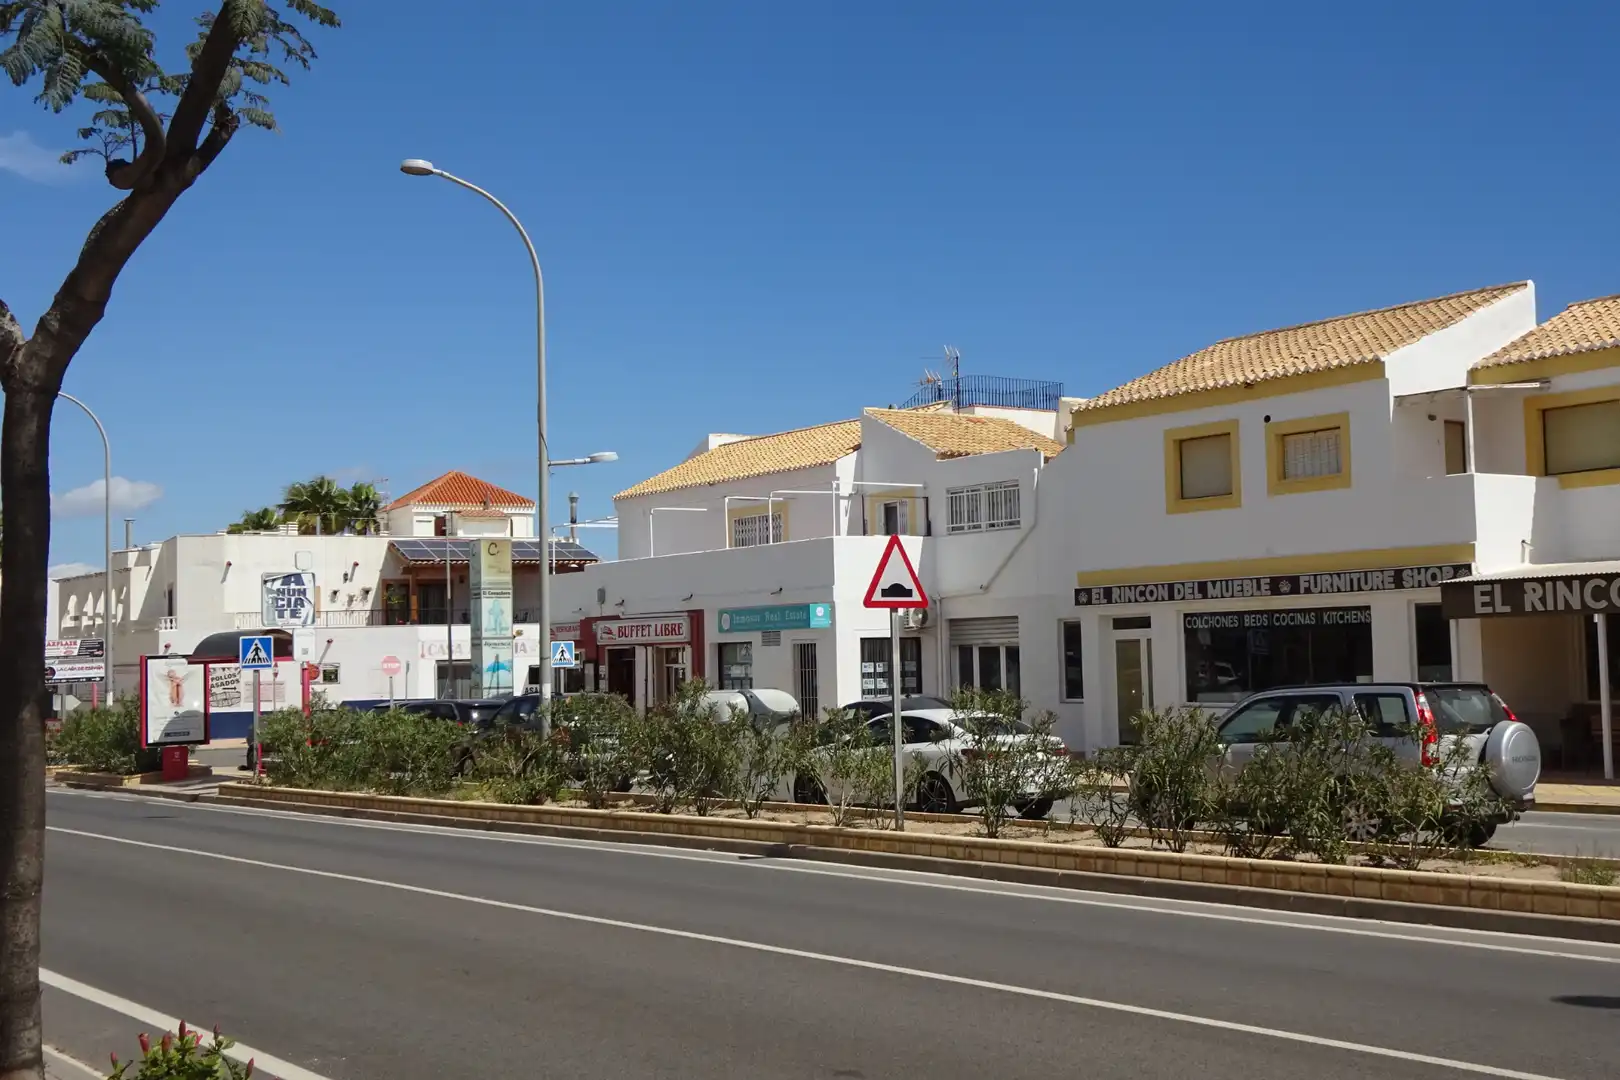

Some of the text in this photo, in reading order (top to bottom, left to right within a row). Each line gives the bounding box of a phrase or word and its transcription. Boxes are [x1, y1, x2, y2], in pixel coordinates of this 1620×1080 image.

[280, 573, 306, 587] A
[1300, 566, 1454, 595] FURNITURE SHOP
[276, 588, 307, 597] NUN
[1091, 578, 1271, 605] EL RINCON DEL MUEBLE
[275, 597, 305, 609] CIA
[1473, 583, 1512, 614] EL
[275, 609, 302, 619] TE
[764, 611, 780, 622] Real
[785, 609, 807, 620] Estate
[1185, 610, 1371, 629] COLCHONES BEDS COCINAS KITCHENS
[617, 622, 684, 638] BUFFET LIBRE
[210, 672, 237, 682] POLLOS
[210, 679, 240, 689] ASADOS
